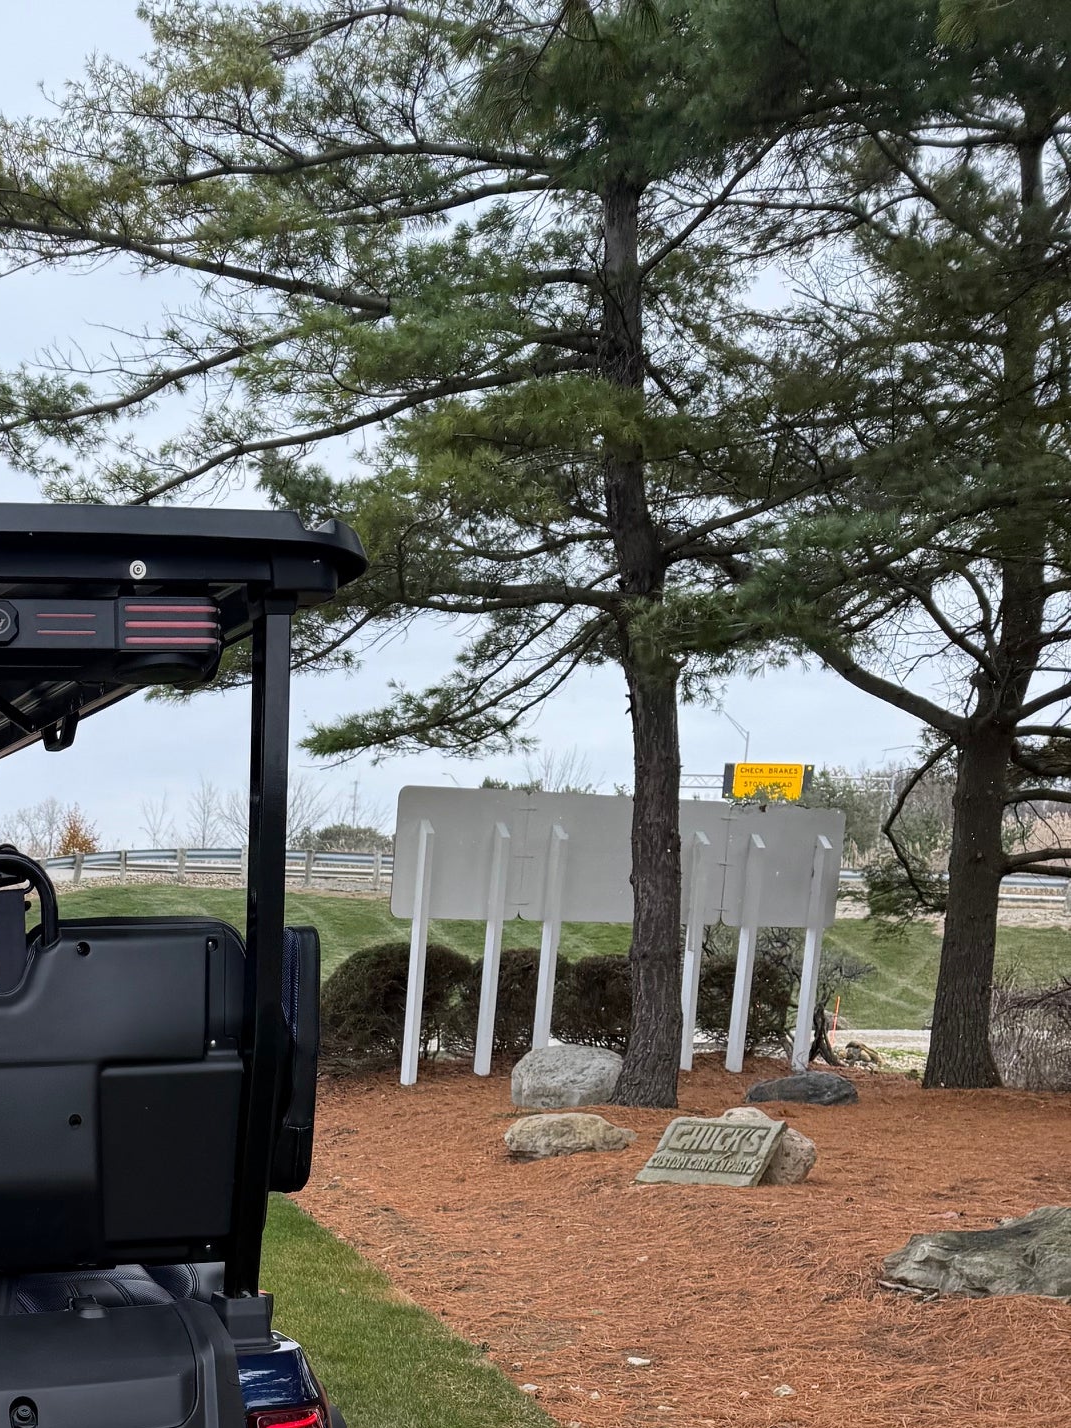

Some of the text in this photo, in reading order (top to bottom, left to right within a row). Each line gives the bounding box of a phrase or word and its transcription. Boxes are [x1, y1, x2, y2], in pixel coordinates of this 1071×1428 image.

[668, 1125, 769, 1153] CHUCK'S
[647, 1154, 688, 1169] CUSTOM
[688, 1157, 719, 1172] CARTS
